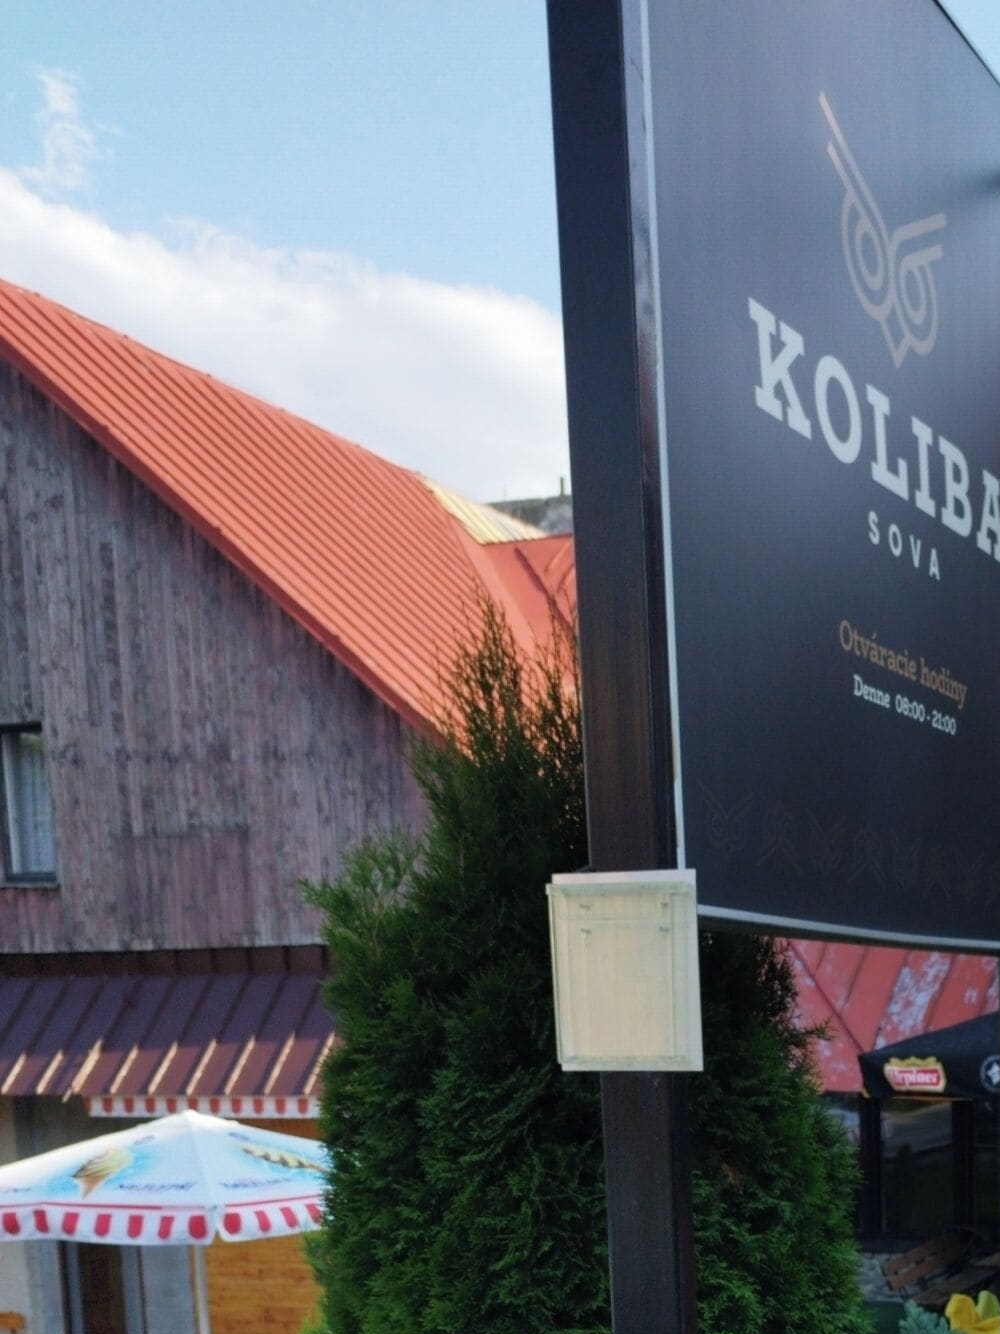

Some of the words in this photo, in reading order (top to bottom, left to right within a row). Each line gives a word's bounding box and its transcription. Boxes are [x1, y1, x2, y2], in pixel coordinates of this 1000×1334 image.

[868, 510, 940, 581] SOVA
[839, 619, 917, 681] Otváracie
[920, 656, 968, 711] hodiny
[853, 673, 891, 708] Denne
[895, 694, 926, 723] 08:00
[931, 710, 957, 735] 21:00
